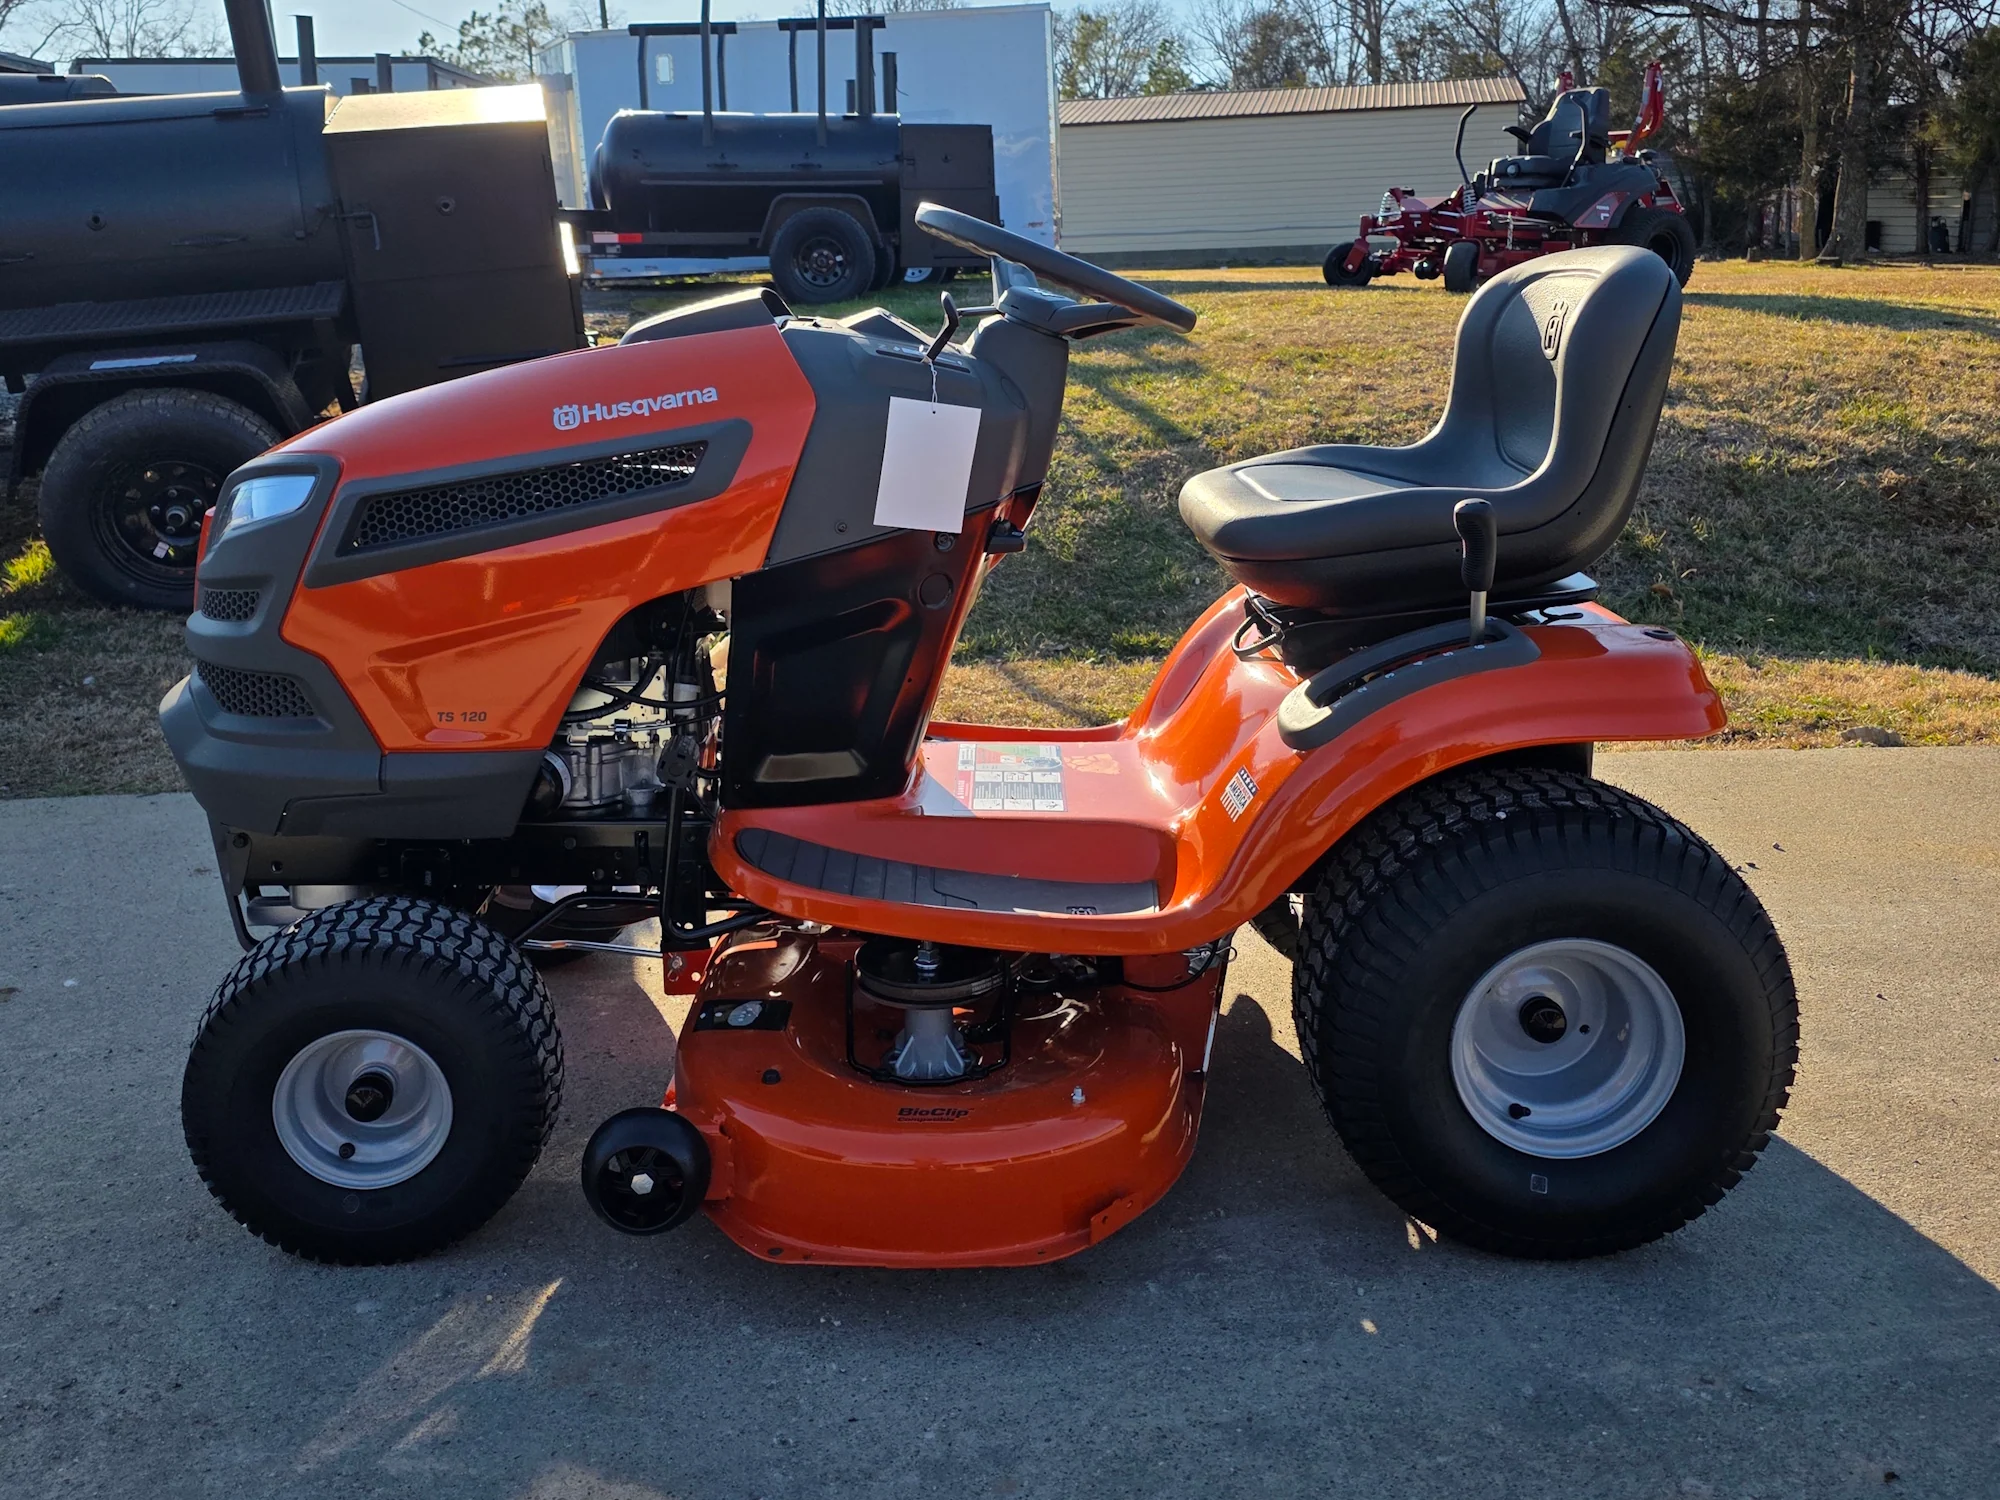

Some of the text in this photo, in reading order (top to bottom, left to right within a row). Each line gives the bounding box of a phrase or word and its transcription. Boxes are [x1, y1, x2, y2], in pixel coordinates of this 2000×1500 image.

[583, 386, 718, 423] Husqvarna
[437, 711, 487, 722] TS 120
[1228, 780, 1247, 809] AMERICA
[898, 1108, 969, 1118] BioClip
